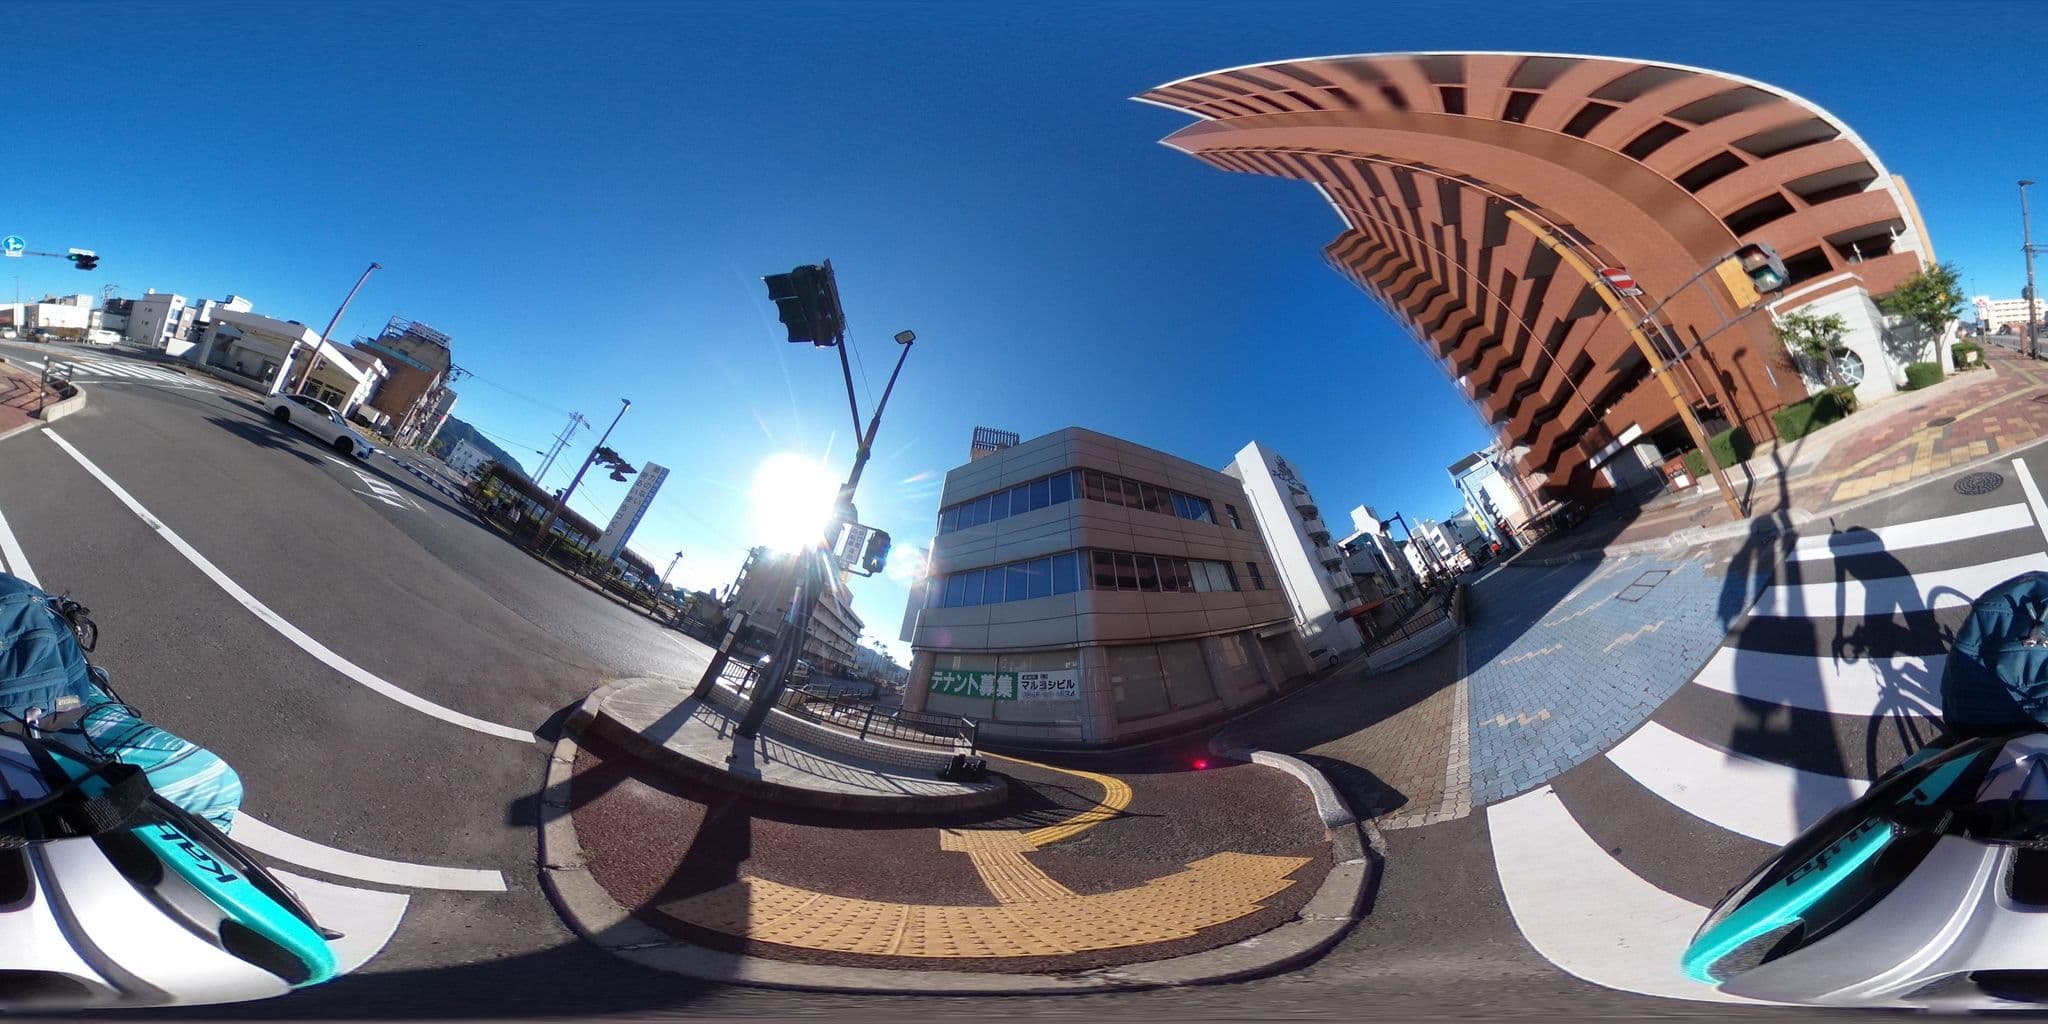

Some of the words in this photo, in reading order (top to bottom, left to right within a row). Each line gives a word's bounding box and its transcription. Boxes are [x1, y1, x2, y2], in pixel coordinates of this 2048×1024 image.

[931, 671, 1013, 698] テナント募集
[1021, 680, 1075, 691] マルヨシビル
